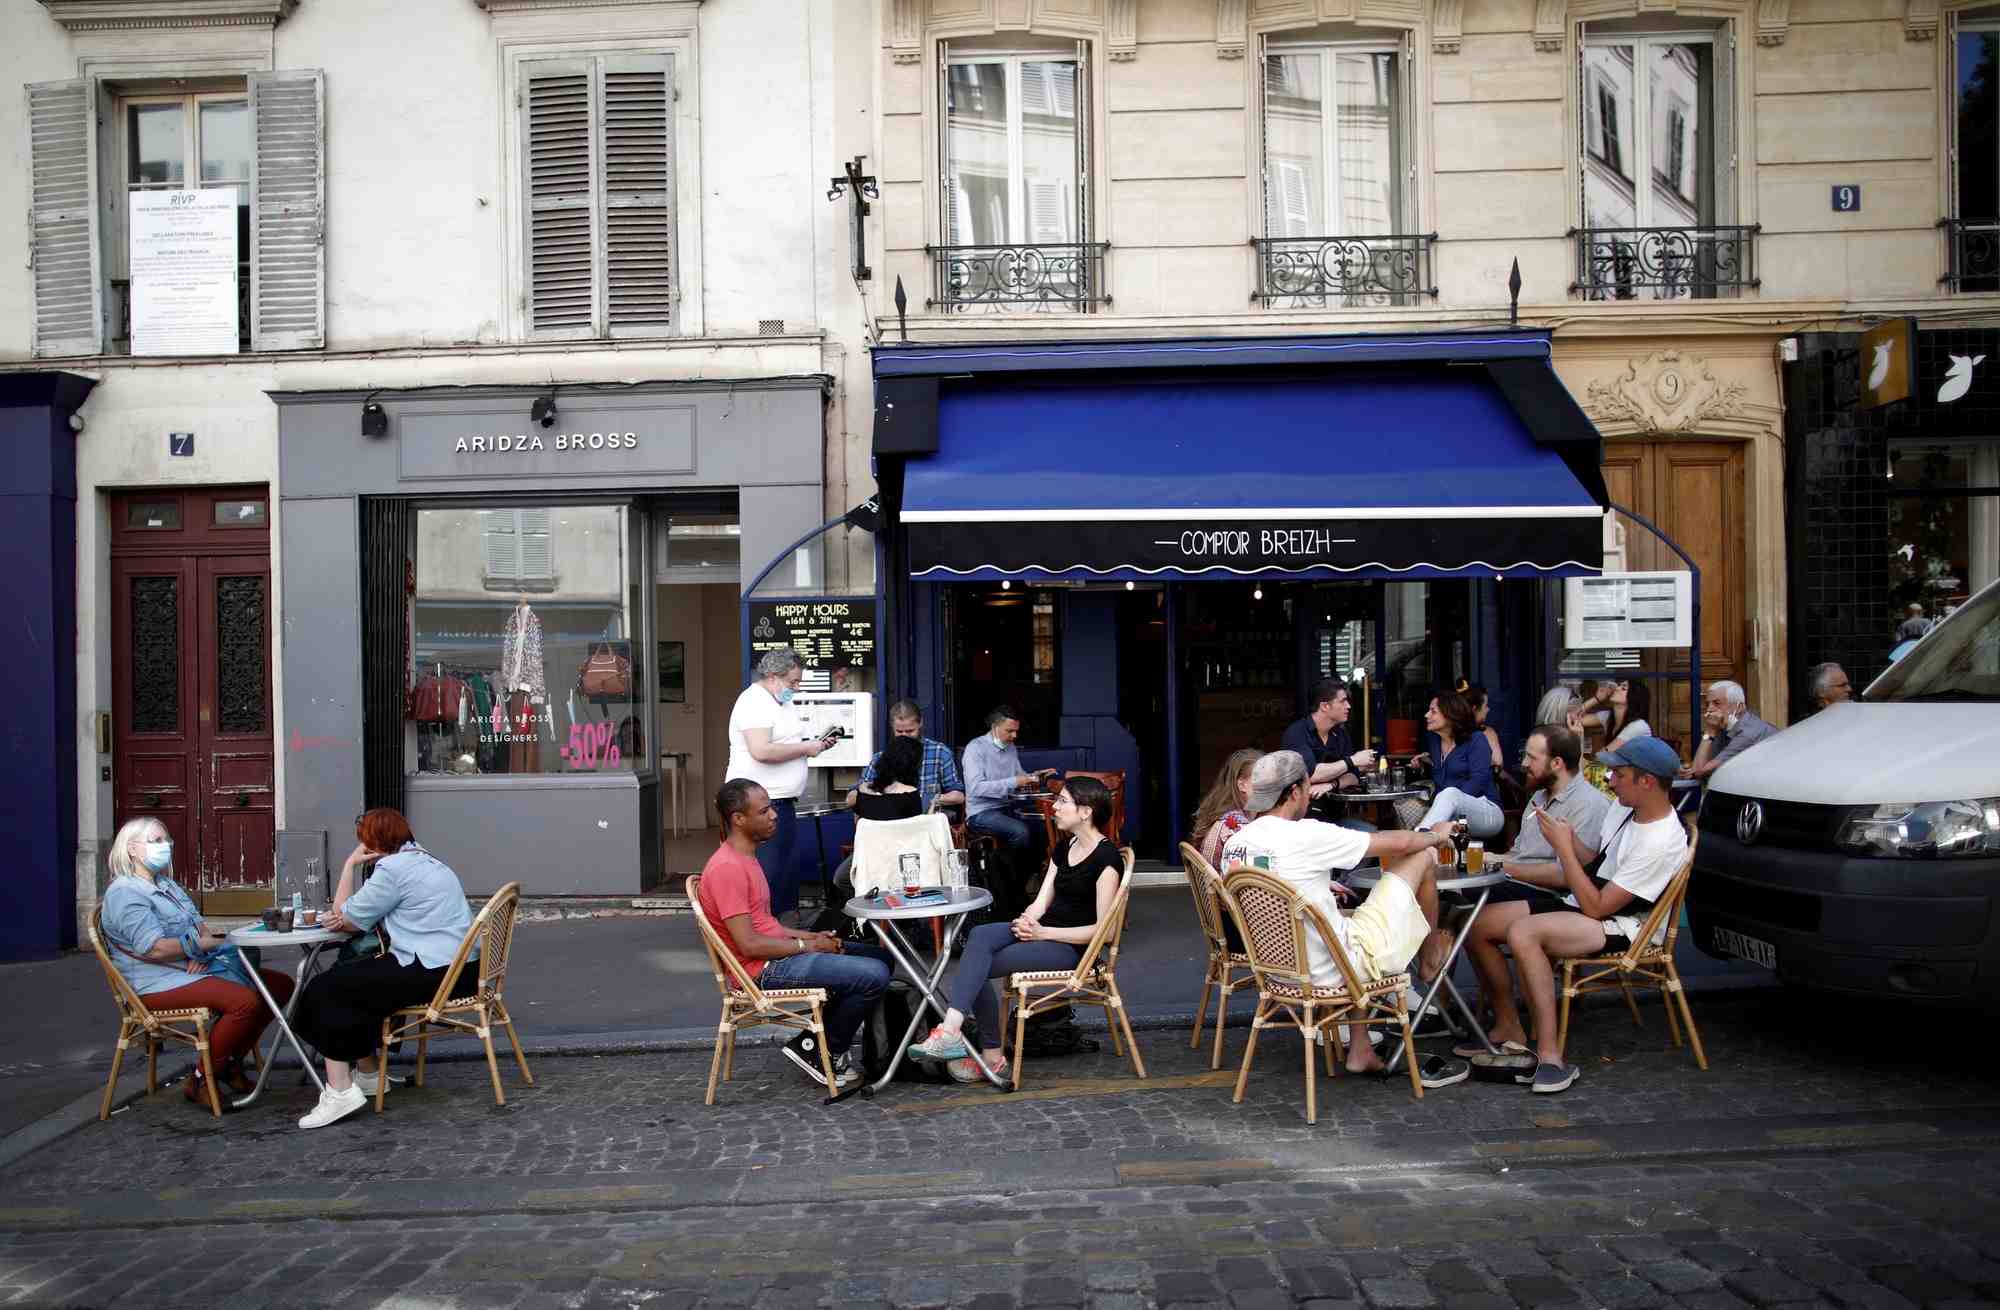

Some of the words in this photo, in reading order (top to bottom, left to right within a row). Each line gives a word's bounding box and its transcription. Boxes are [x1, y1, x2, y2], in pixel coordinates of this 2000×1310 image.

[1839, 188, 1853, 209] 9
[1665, 374, 1679, 399] 9
[175, 434, 188, 454] 7
[455, 436, 544, 452] ARIDZA
[556, 433, 638, 449] BROSS
[1180, 530, 1250, 555] COMPTOIR
[1261, 529, 1331, 555] BREIZH
[775, 605, 808, 617] HAPPY
[813, 604, 849, 616] HOURS
[470, 715, 510, 724] ARIDZA
[515, 714, 550, 723] BROSS
[480, 734, 538, 743] DESIGNERS
[560, 720, 621, 769] -50%
